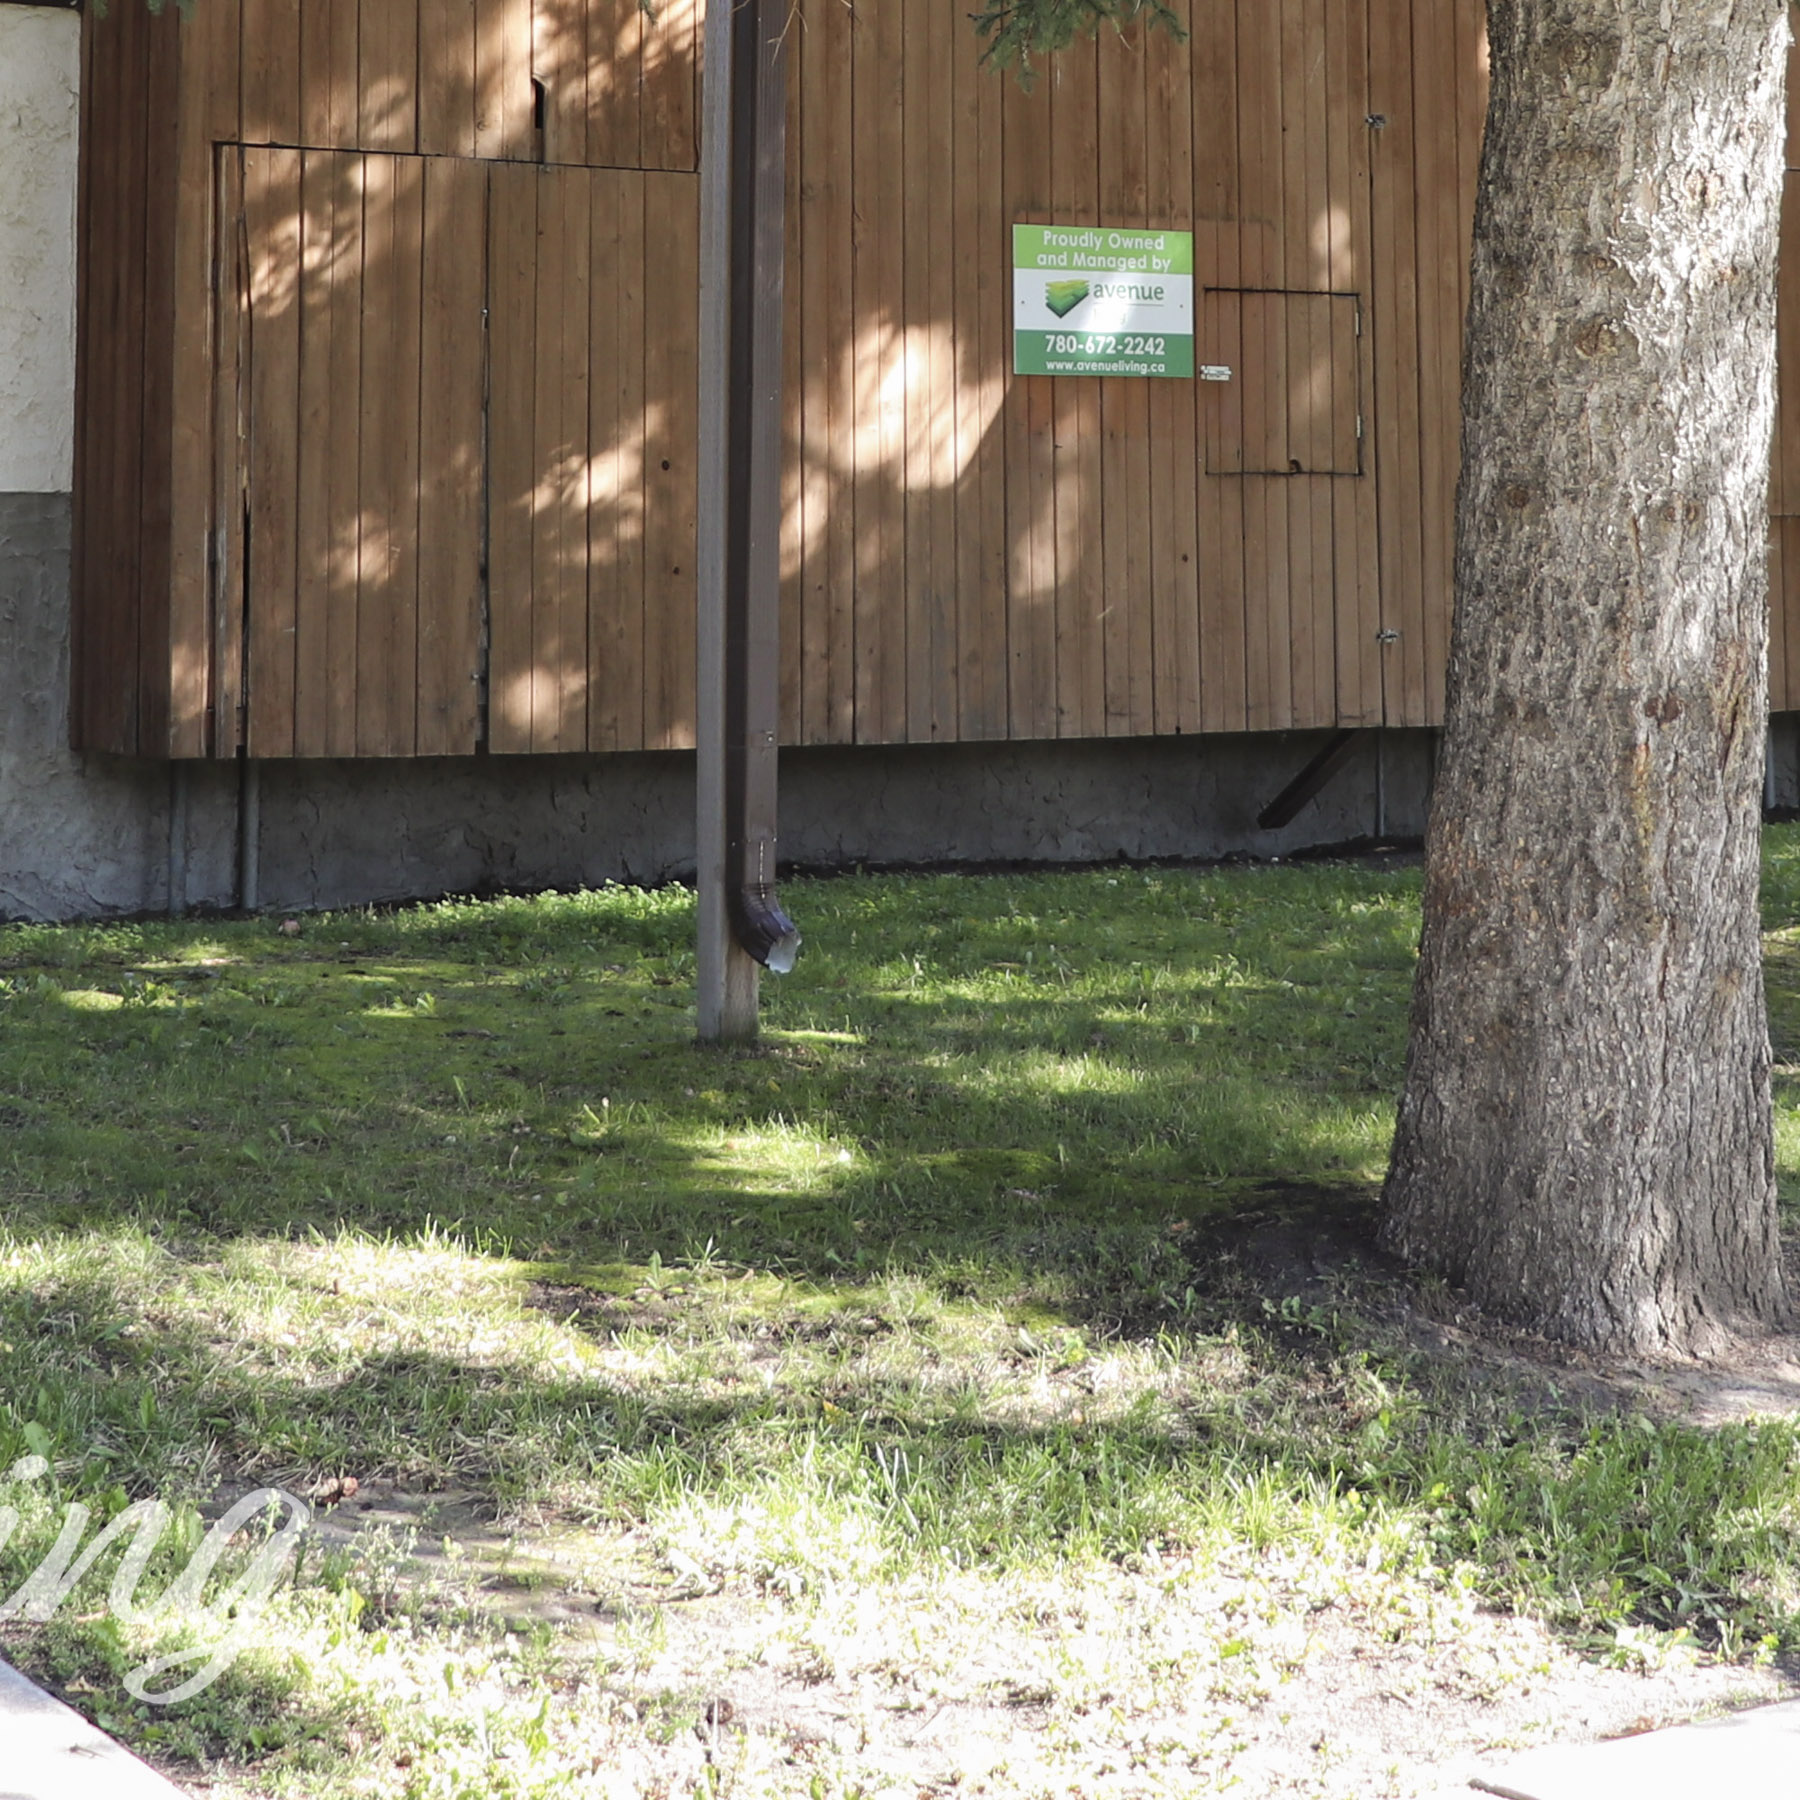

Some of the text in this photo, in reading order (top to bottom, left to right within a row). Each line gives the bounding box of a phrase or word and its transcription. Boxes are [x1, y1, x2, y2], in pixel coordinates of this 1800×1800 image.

[1043, 230, 1165, 251] Proudly Owned
[1037, 252, 1172, 273] and Managed by
[1093, 282, 1164, 300] avenue
[1045, 334, 1166, 356] 780-672-2242
[1046, 359, 1166, 375] www.avenueliving.ca
